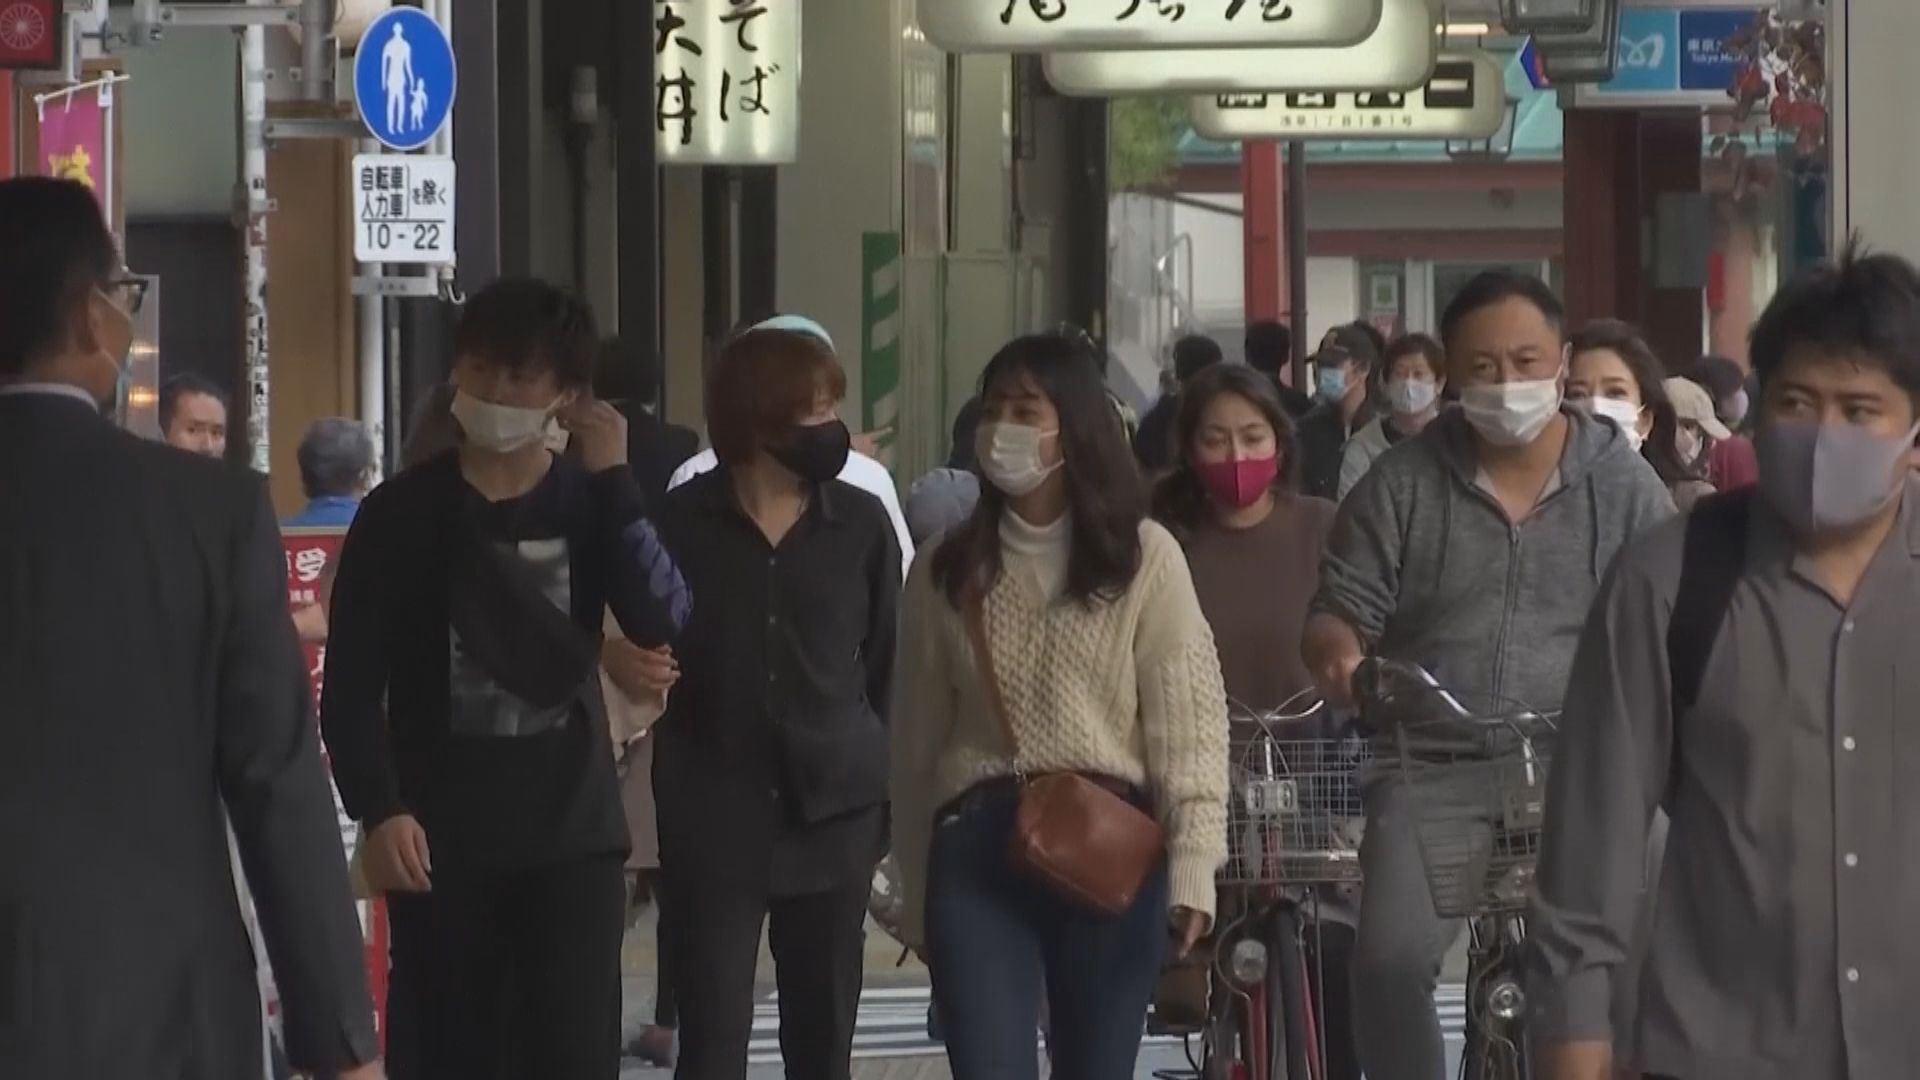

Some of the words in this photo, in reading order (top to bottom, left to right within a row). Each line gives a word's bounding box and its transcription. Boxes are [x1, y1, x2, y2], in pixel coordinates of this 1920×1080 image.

[719, 0, 780, 122] そば
[361, 165, 403, 191] 自転車
[413, 178, 446, 205] を除く
[361, 192, 404, 219] 人力車
